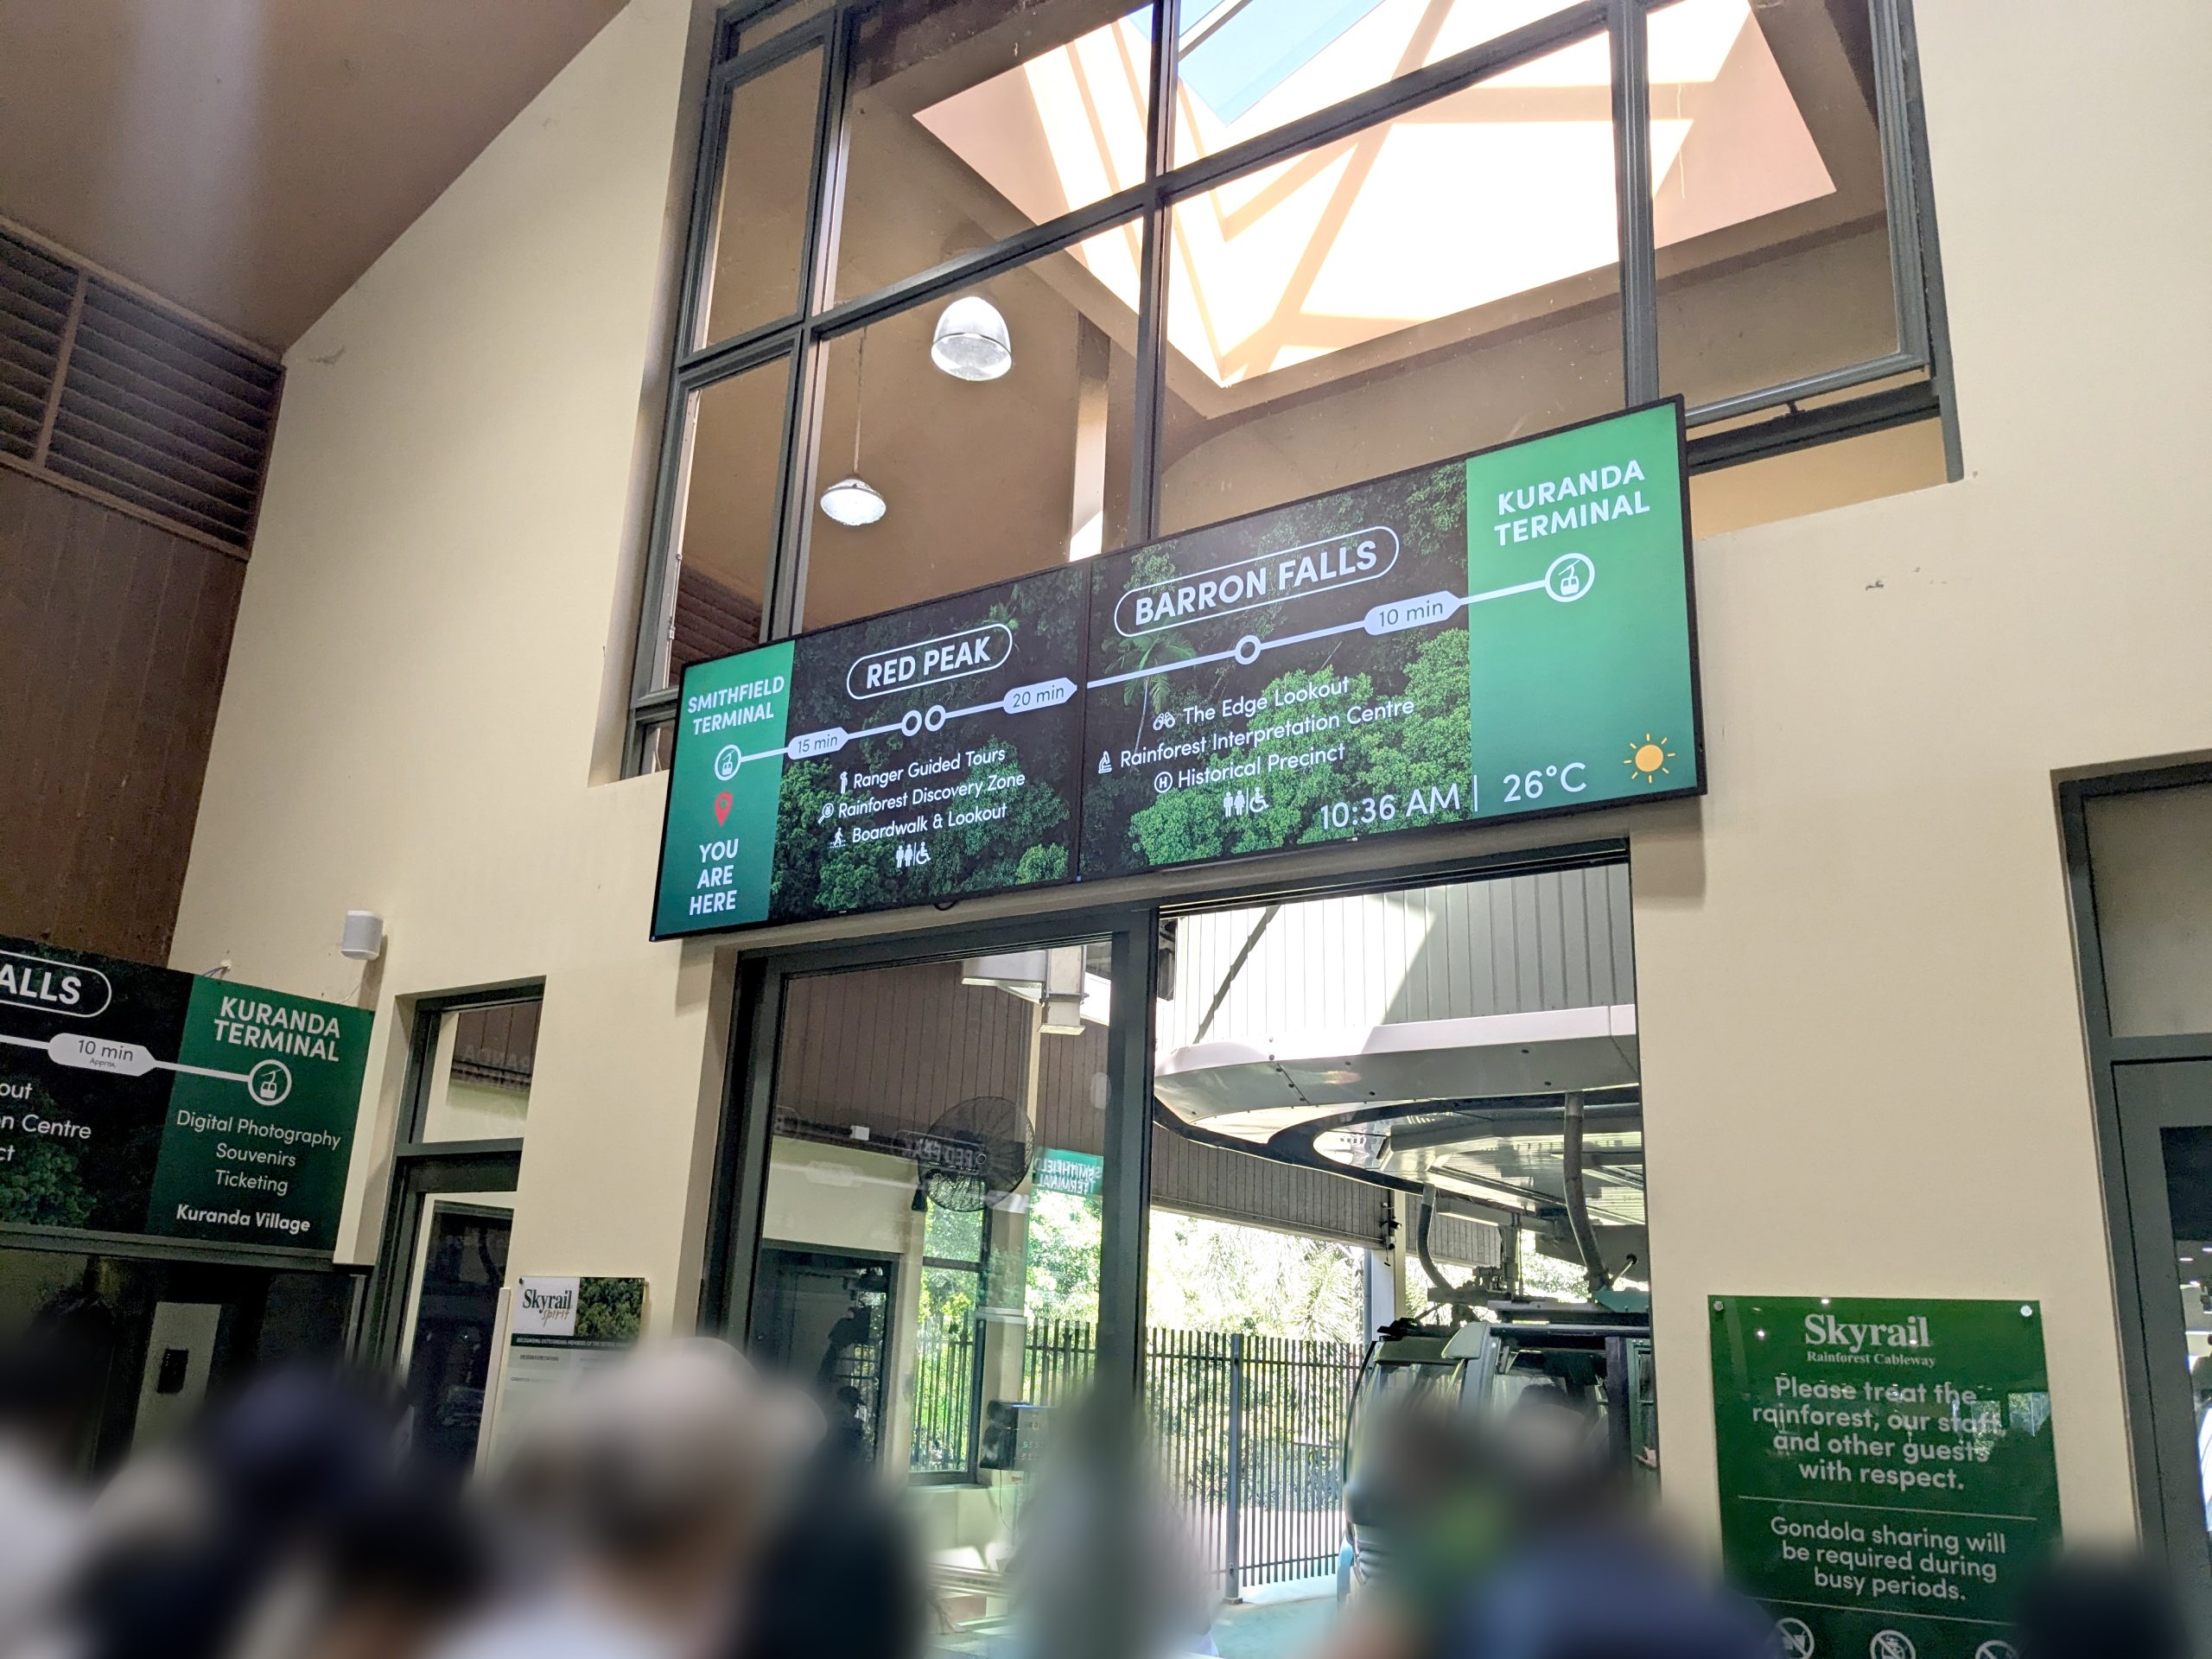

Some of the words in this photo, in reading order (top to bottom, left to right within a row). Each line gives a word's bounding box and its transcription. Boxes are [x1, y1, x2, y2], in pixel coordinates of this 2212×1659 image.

[1497, 459, 1646, 516] KURANDA
[1494, 491, 1650, 547] TERMINAL
[1135, 567, 1267, 626] BARRON
[1278, 540, 1377, 591] FALLS
[1378, 609, 1399, 626] 10
[1406, 600, 1443, 622] min
[866, 656, 916, 689] RED
[923, 636, 991, 677] PEAK
[688, 676, 785, 715] SMITHFIELD
[1012, 690, 1033, 708] 20
[1035, 684, 1065, 703] min
[1184, 706, 1216, 725] The
[1222, 696, 1268, 720] Edge
[1274, 676, 1351, 707] Lookout
[692, 702, 775, 735] TERMINAL
[1120, 736, 1208, 768] Rainforest
[1212, 714, 1341, 751] Interpretation
[1346, 700, 1415, 726] Centre
[797, 737, 811, 753] 15
[814, 733, 839, 751] min
[852, 767, 905, 792] Ranger
[908, 755, 962, 779] Guided
[964, 747, 1006, 768] Tours
[1177, 757, 1262, 788] Historical
[1268, 742, 1346, 772] Precinct
[837, 793, 909, 819] Rainforest
[912, 780, 983, 807] Discovery
[988, 772, 1026, 792] Zone
[1503, 762, 1588, 804] 26°C
[851, 817, 929, 844] Boardwalk
[932, 812, 944, 830] &
[947, 803, 1007, 828] Lookout
[1320, 793, 1396, 830] 10:36
[1405, 783, 1460, 817] AM
[698, 838, 740, 863] YOU
[696, 864, 734, 890] ARE
[689, 889, 737, 916] HERE
[0, 963, 82, 1005] ALLS
[219, 995, 341, 1039] KURANDA
[78, 1039, 97, 1055] 10
[101, 1045, 134, 1062] min
[213, 1019, 340, 1063] TERMINAL
[0, 1082, 33, 1100] out
[0, 1115, 15, 1130] n
[22, 1114, 92, 1140] Centre
[176, 1109, 233, 1135] Digital
[237, 1118, 341, 1152] Photography
[215, 1142, 296, 1168] Souvenirs
[215, 1170, 289, 1197] Ticketing
[175, 1204, 251, 1228] Kuranda
[255, 1211, 311, 1234] Village
[522, 1288, 573, 1313] Skyrail
[541, 1308, 570, 1327] spirit
[1805, 1313, 1932, 1353] Skyrail
[1807, 1351, 1871, 1365] Rainforest
[1873, 1353, 1936, 1369] Cableway
[1774, 1376, 1857, 1401] Please
[1864, 1382, 1927, 1403] treat
[1933, 1382, 1977, 1405] the
[1752, 1403, 1880, 1431] rainforest,
[1887, 1413, 1936, 1432] our
[1938, 1413, 2001, 1435] staff
[1773, 1432, 1820, 1453] and
[1827, 1434, 1896, 1458] other
[1902, 1442, 1990, 1465] guests
[1798, 1462, 1852, 1483] with
[1859, 1469, 1965, 1491] respect.
[1770, 1516, 1866, 1543] Gondola
[1872, 1525, 1960, 1555] sharing
[1966, 1532, 2006, 1554] will
[1782, 1540, 1810, 1561] be
[1816, 1546, 1913, 1571] required
[1920, 1554, 1997, 1584] during
[1814, 1567, 1866, 1596] busy
[1872, 1572, 1967, 1601] periods.
